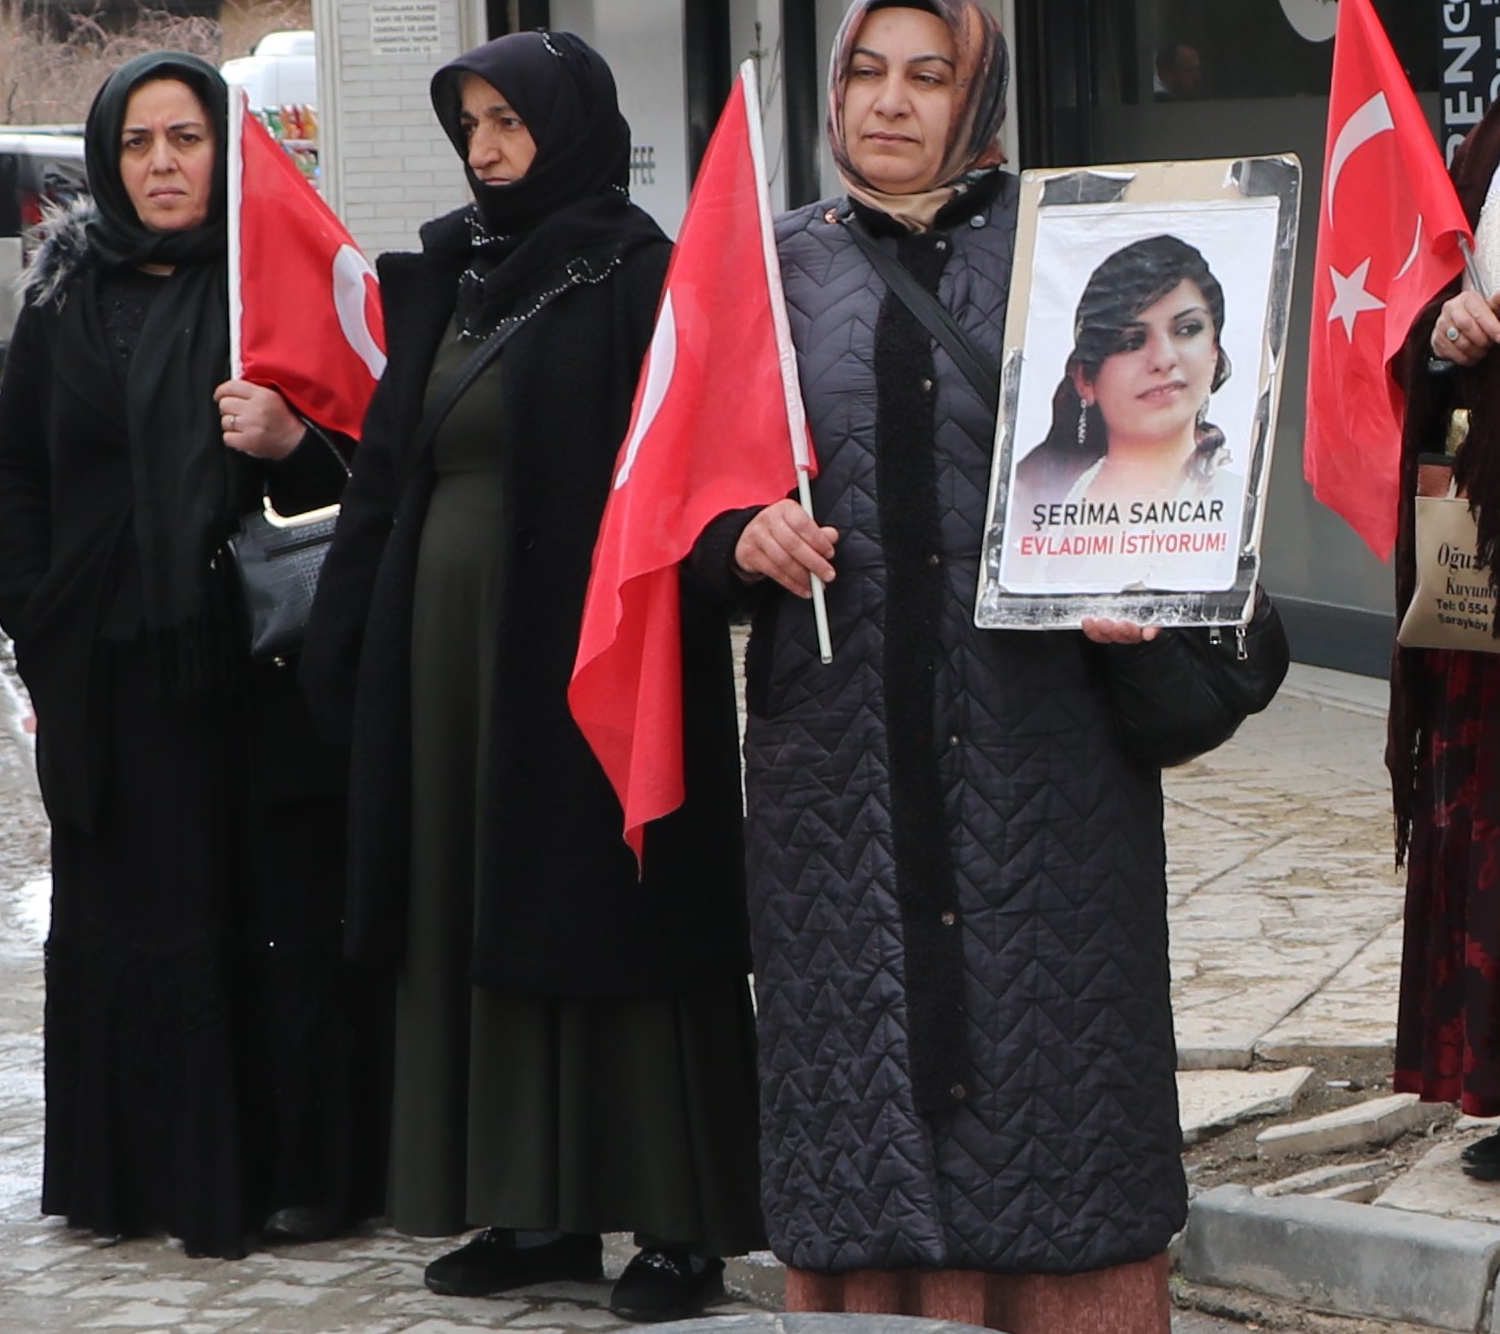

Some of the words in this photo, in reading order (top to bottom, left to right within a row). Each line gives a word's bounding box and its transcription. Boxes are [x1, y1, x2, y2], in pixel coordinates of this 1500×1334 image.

[1032, 498, 1120, 531] ŞERİMA
[1129, 500, 1224, 524] SANCAR
[1020, 536, 1114, 555] EVLADIMI
[1120, 530, 1227, 555] İSTİYORUM!
[1436, 598, 1456, 611] Tel:
